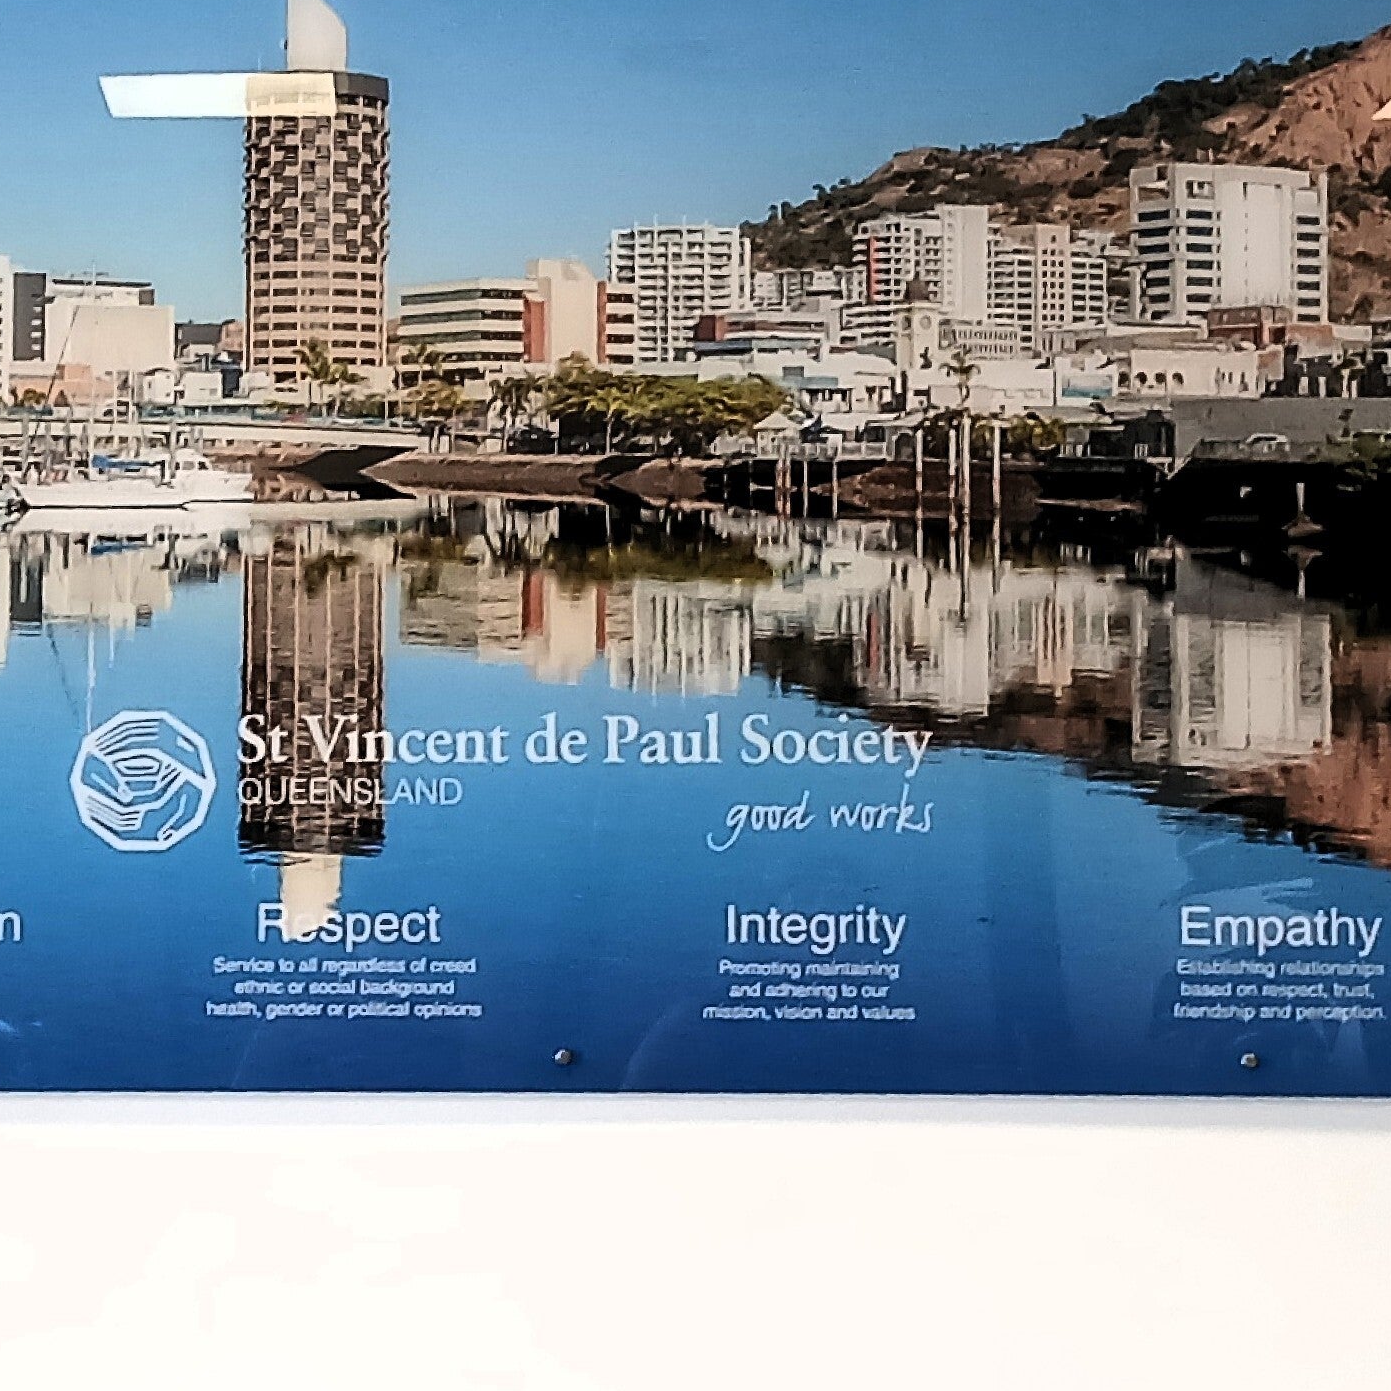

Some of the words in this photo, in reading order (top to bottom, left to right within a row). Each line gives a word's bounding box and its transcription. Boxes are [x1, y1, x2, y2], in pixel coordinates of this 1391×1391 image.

[237, 713, 287, 765] St
[307, 713, 510, 765] Vincent
[524, 713, 588, 765] de
[604, 712, 721, 765] Paul
[739, 712, 932, 777] Society
[237, 776, 463, 807] QUEENSLAND
[707, 789, 814, 852] good
[830, 783, 935, 832] works
[727, 904, 906, 955] Integrity
[1180, 906, 1382, 957] Empathy
[213, 956, 275, 974] Service
[278, 957, 294, 973] to
[298, 957, 318, 973] all
[321, 957, 405, 977] regardless
[409, 957, 426, 973] of
[429, 957, 476, 973] creed
[718, 959, 801, 979] Promoting
[806, 959, 900, 980] maintaining
[1176, 959, 1276, 978] Establishing
[1280, 960, 1385, 979] relationships
[234, 979, 284, 995] ethnic
[288, 981, 306, 995] or
[309, 979, 356, 995] social
[360, 979, 454, 998] background
[729, 981, 761, 997] and
[764, 981, 837, 1002] adhering
[841, 982, 857, 997] to
[861, 984, 890, 997] our
[1180, 980, 1232, 997] based
[1236, 983, 1258, 997] on
[1262, 982, 1328, 1000] respect,
[1333, 982, 1375, 999] trust,
[206, 1000, 262, 1019] health,
[265, 1002, 325, 1020] gender
[327, 1003, 346, 1017] or
[348, 1001, 410, 1020] political
[413, 1002, 482, 1020] opinions
[702, 1003, 771, 1021] mission,
[774, 1003, 823, 1020] vision
[827, 1004, 858, 1020] and
[861, 1005, 916, 1020] values
[1173, 1003, 1257, 1023] friendship
[1260, 1003, 1292, 1020] and
